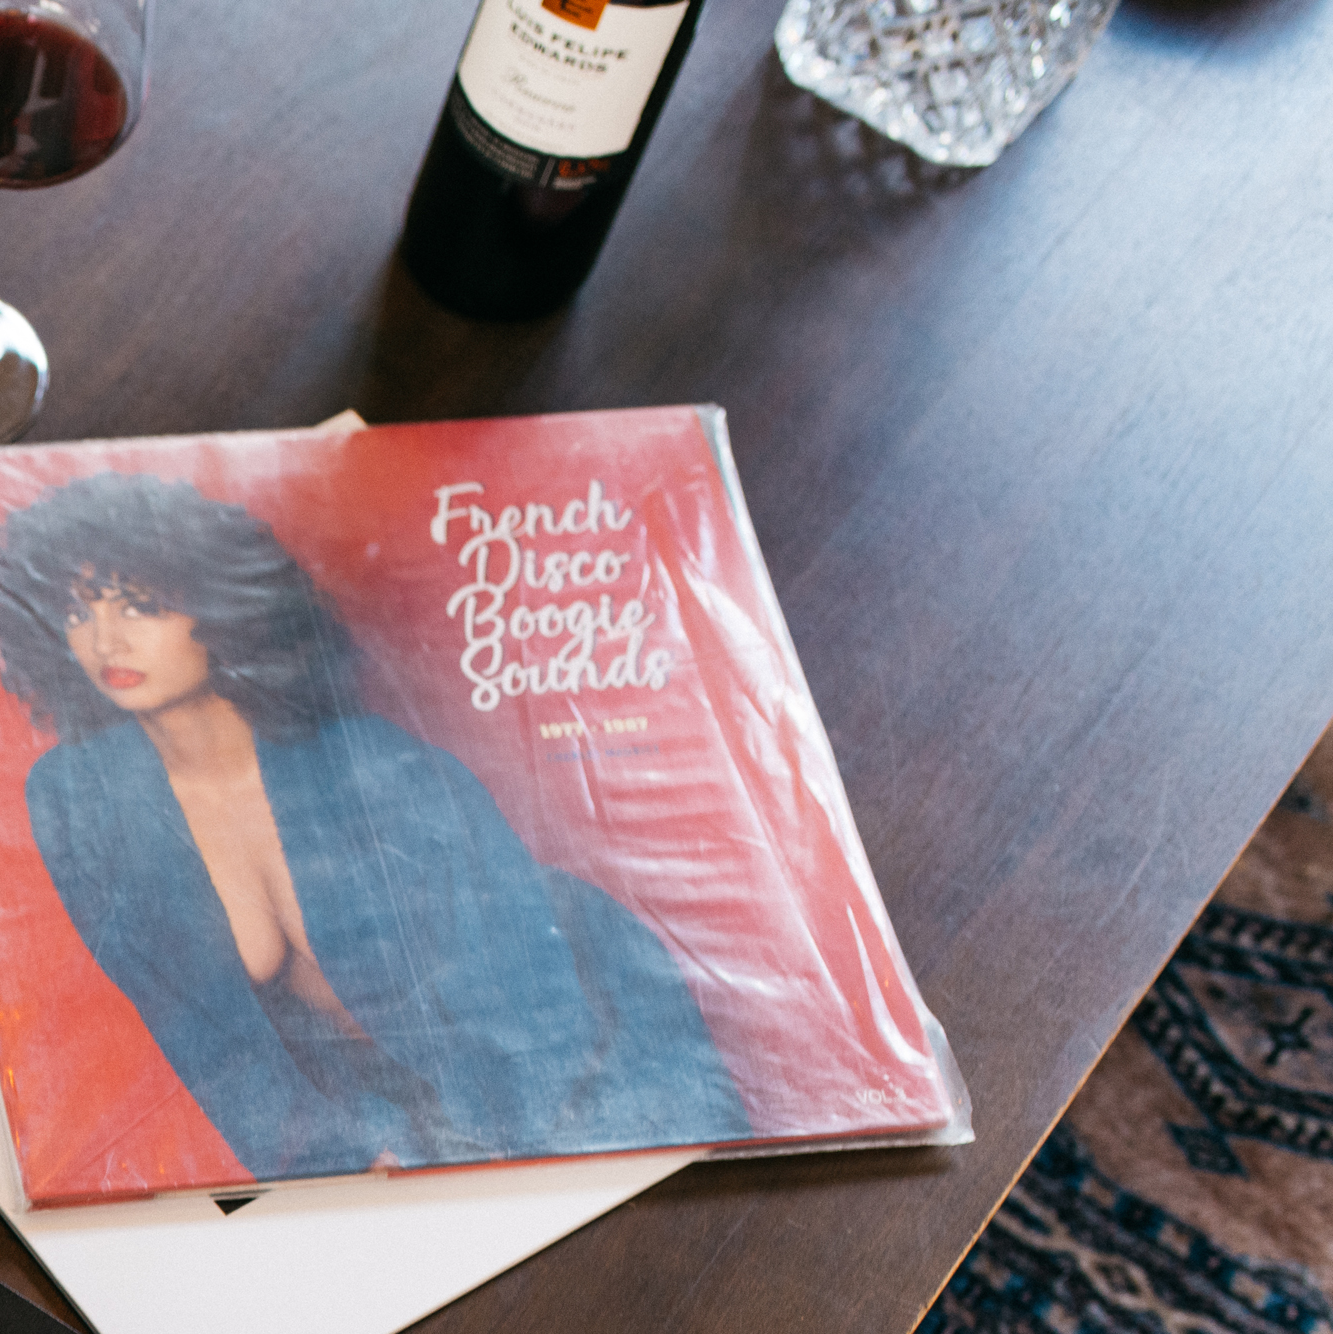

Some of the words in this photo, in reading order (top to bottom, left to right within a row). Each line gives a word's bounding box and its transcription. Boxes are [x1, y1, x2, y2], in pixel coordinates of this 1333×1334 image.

[511, 21, 608, 72] EDWARDS
[550, 31, 629, 60] FELIPE
[430, 479, 633, 544] French
[458, 532, 632, 593] Disco
[445, 582, 657, 672] Boogie
[459, 632, 673, 712] Sounds
